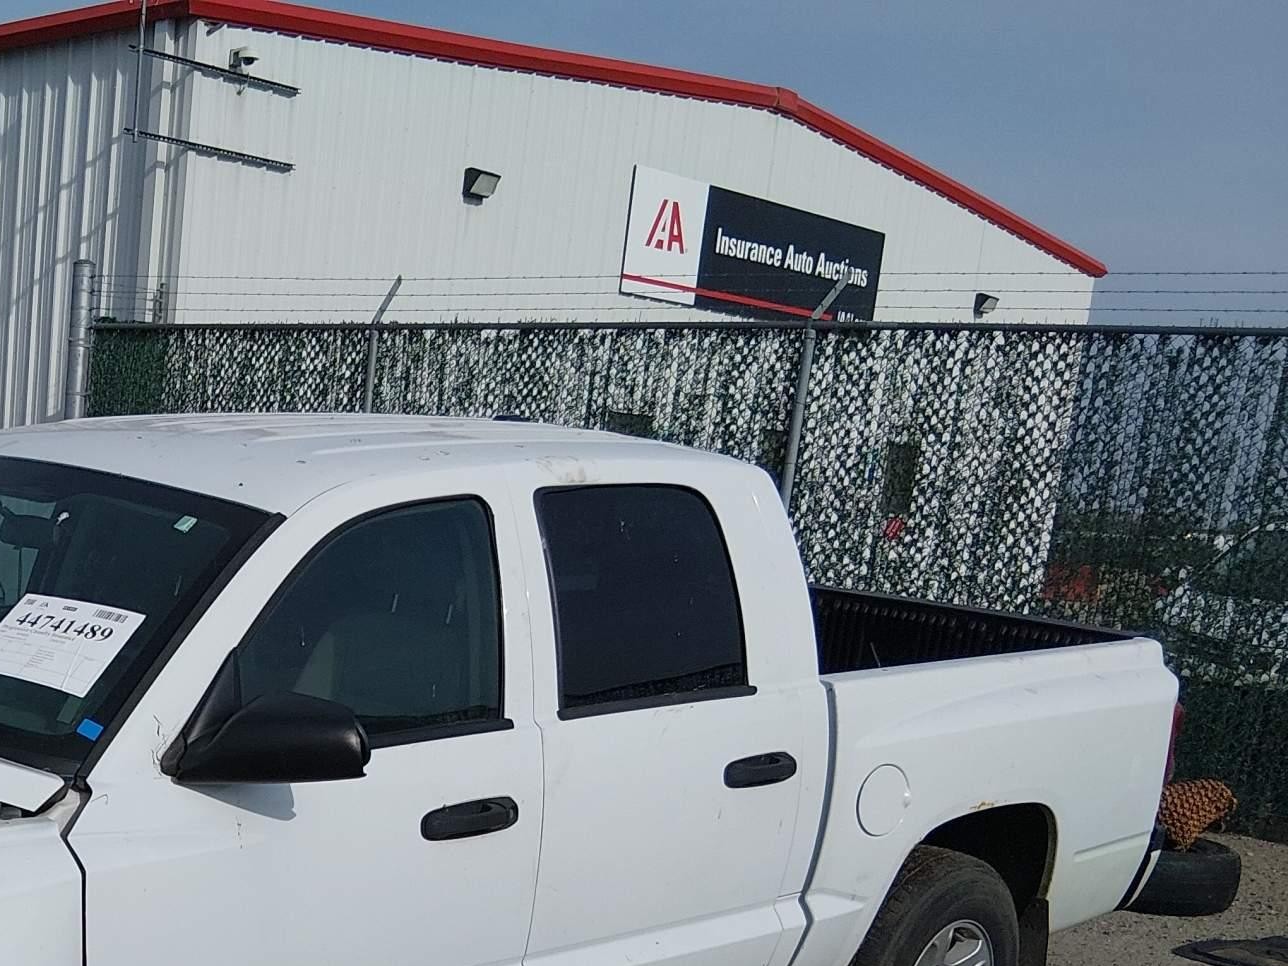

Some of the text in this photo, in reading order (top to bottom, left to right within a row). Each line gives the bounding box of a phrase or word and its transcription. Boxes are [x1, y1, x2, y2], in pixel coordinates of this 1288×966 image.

[715, 227, 782, 267] Insurance
[784, 244, 813, 275] Auto
[16, 611, 114, 642] 44741489
